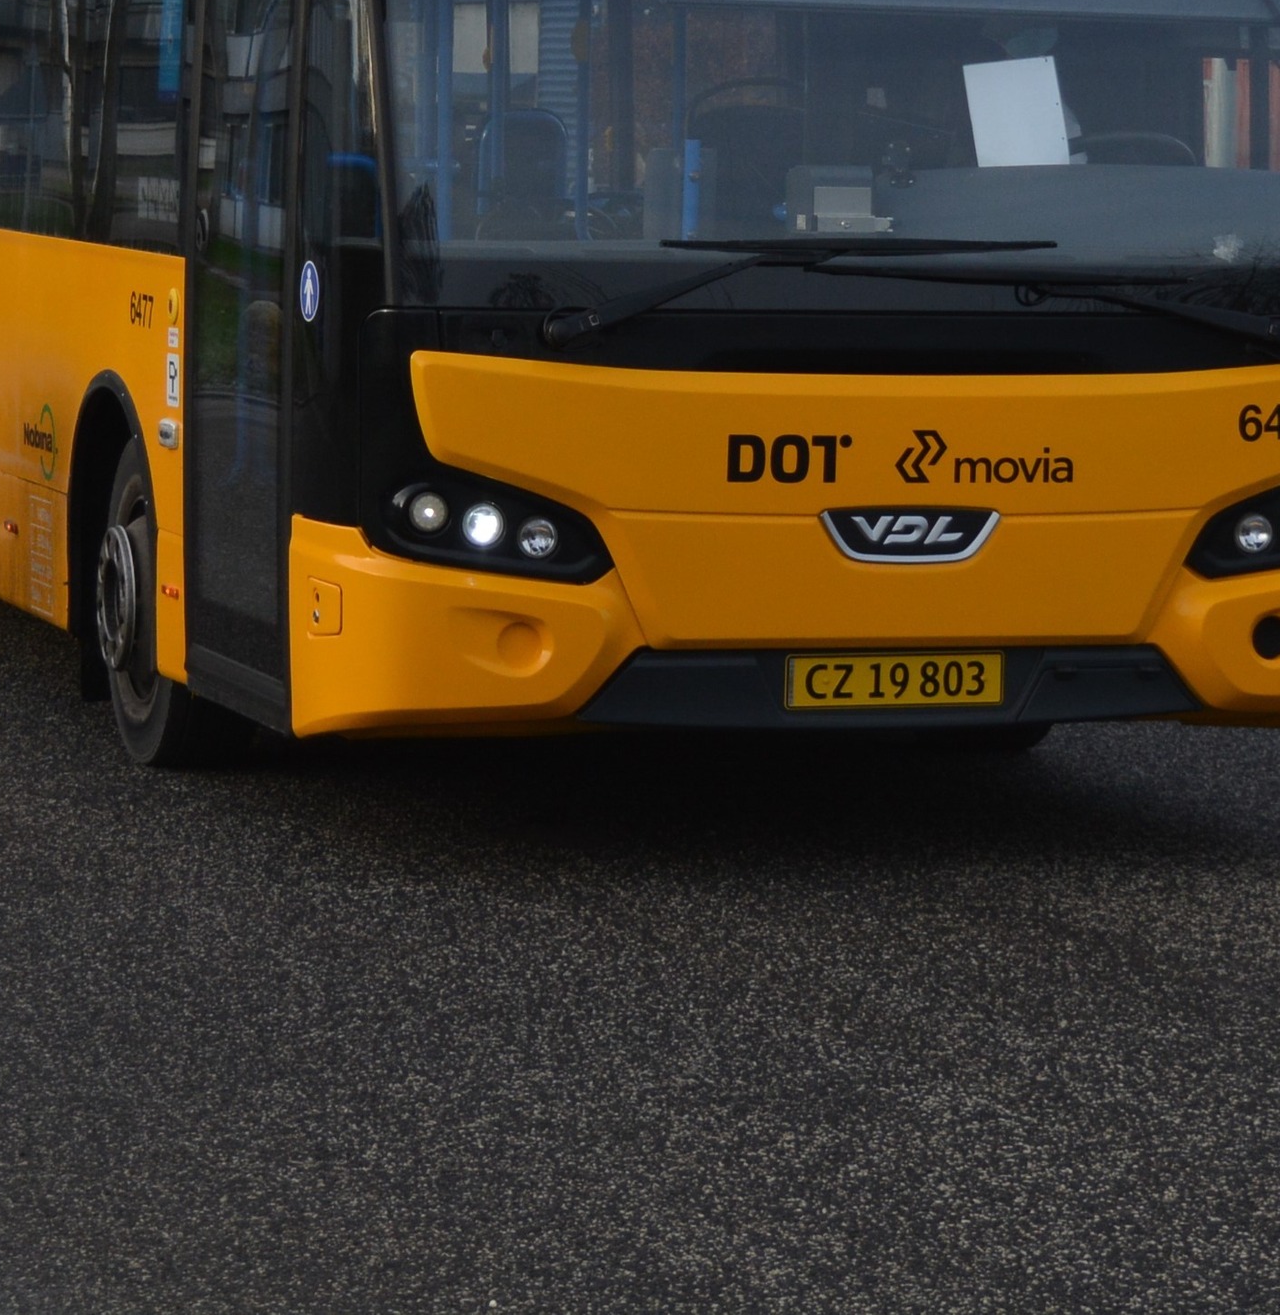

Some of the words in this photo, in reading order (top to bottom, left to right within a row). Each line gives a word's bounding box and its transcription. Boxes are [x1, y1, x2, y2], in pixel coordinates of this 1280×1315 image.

[129, 290, 154, 330] 6477
[23, 421, 53, 453] Nobina
[726, 434, 853, 484] DOT
[953, 447, 1074, 484] movia
[850, 515, 964, 546] VDL
[805, 664, 854, 699] CZ
[868, 662, 910, 699] 19
[919, 661, 985, 698] 803
